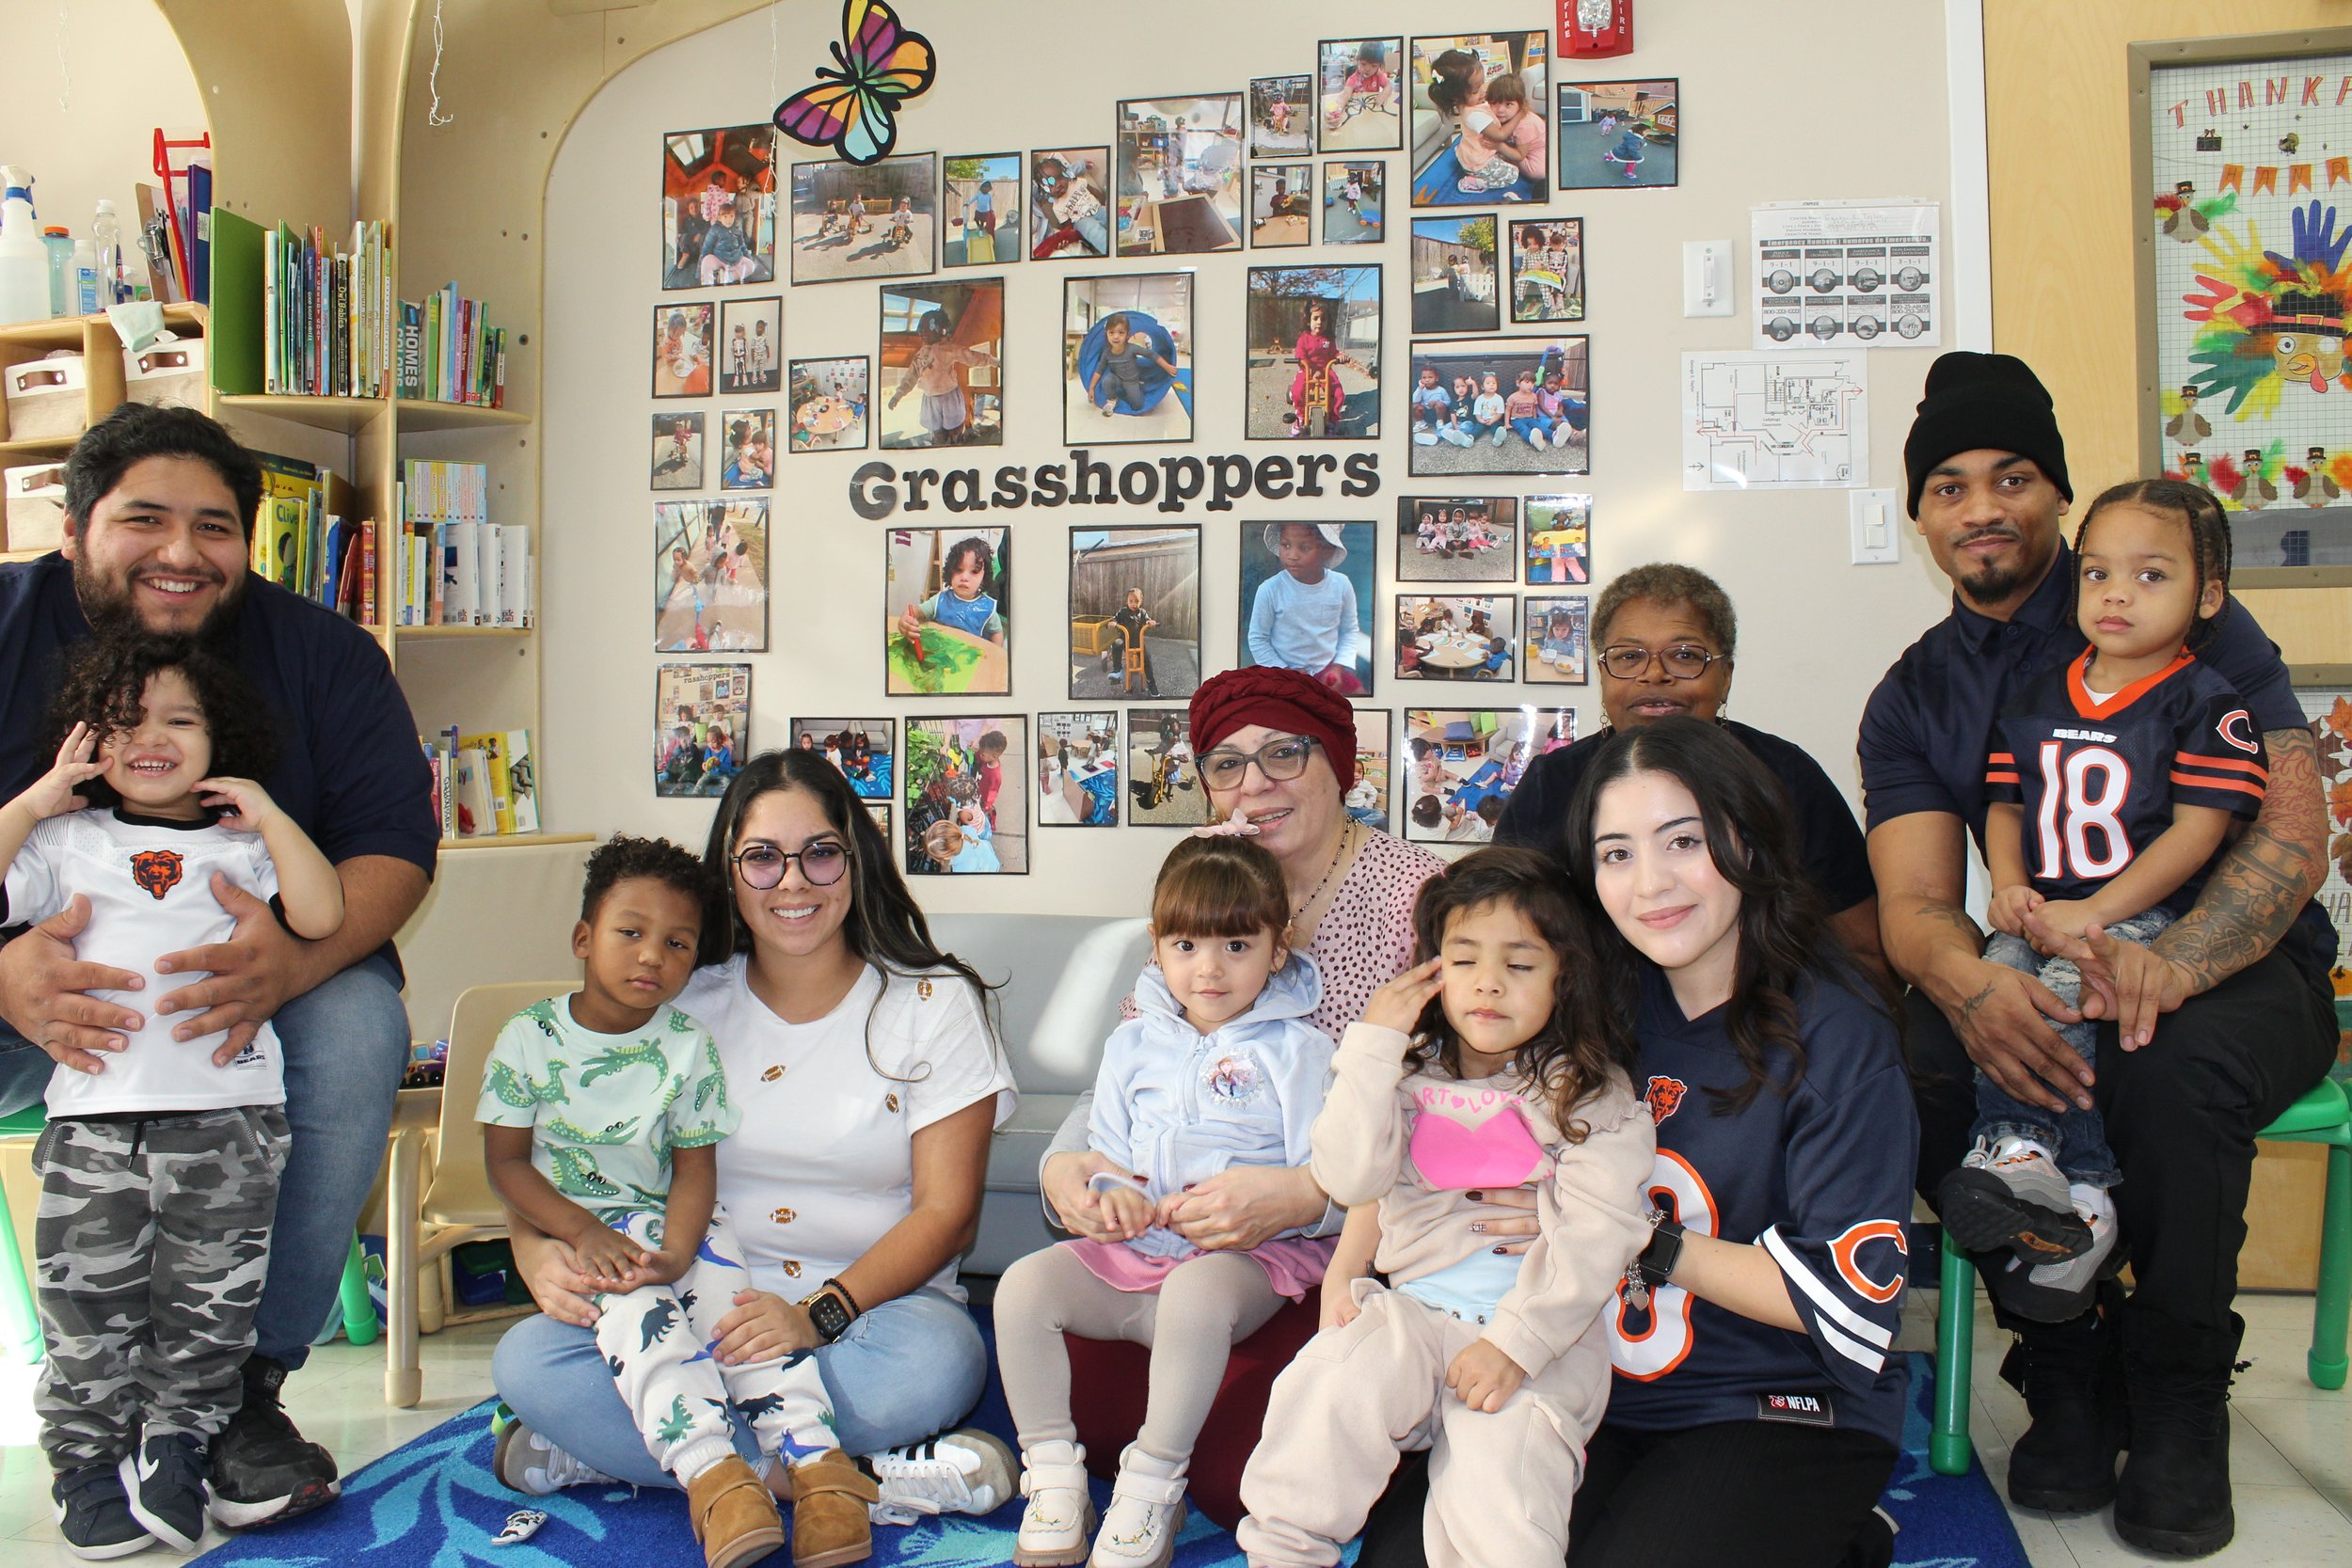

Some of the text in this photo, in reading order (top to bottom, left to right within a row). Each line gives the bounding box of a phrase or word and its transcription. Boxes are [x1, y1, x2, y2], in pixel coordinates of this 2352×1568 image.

[405, 325, 419, 387] HOMES
[849, 449, 1381, 521] Grasshoppers
[2052, 728, 2117, 744] BEARS
[2035, 740, 2133, 879] 18
[1785, 1395, 1820, 1412] NFLPA
